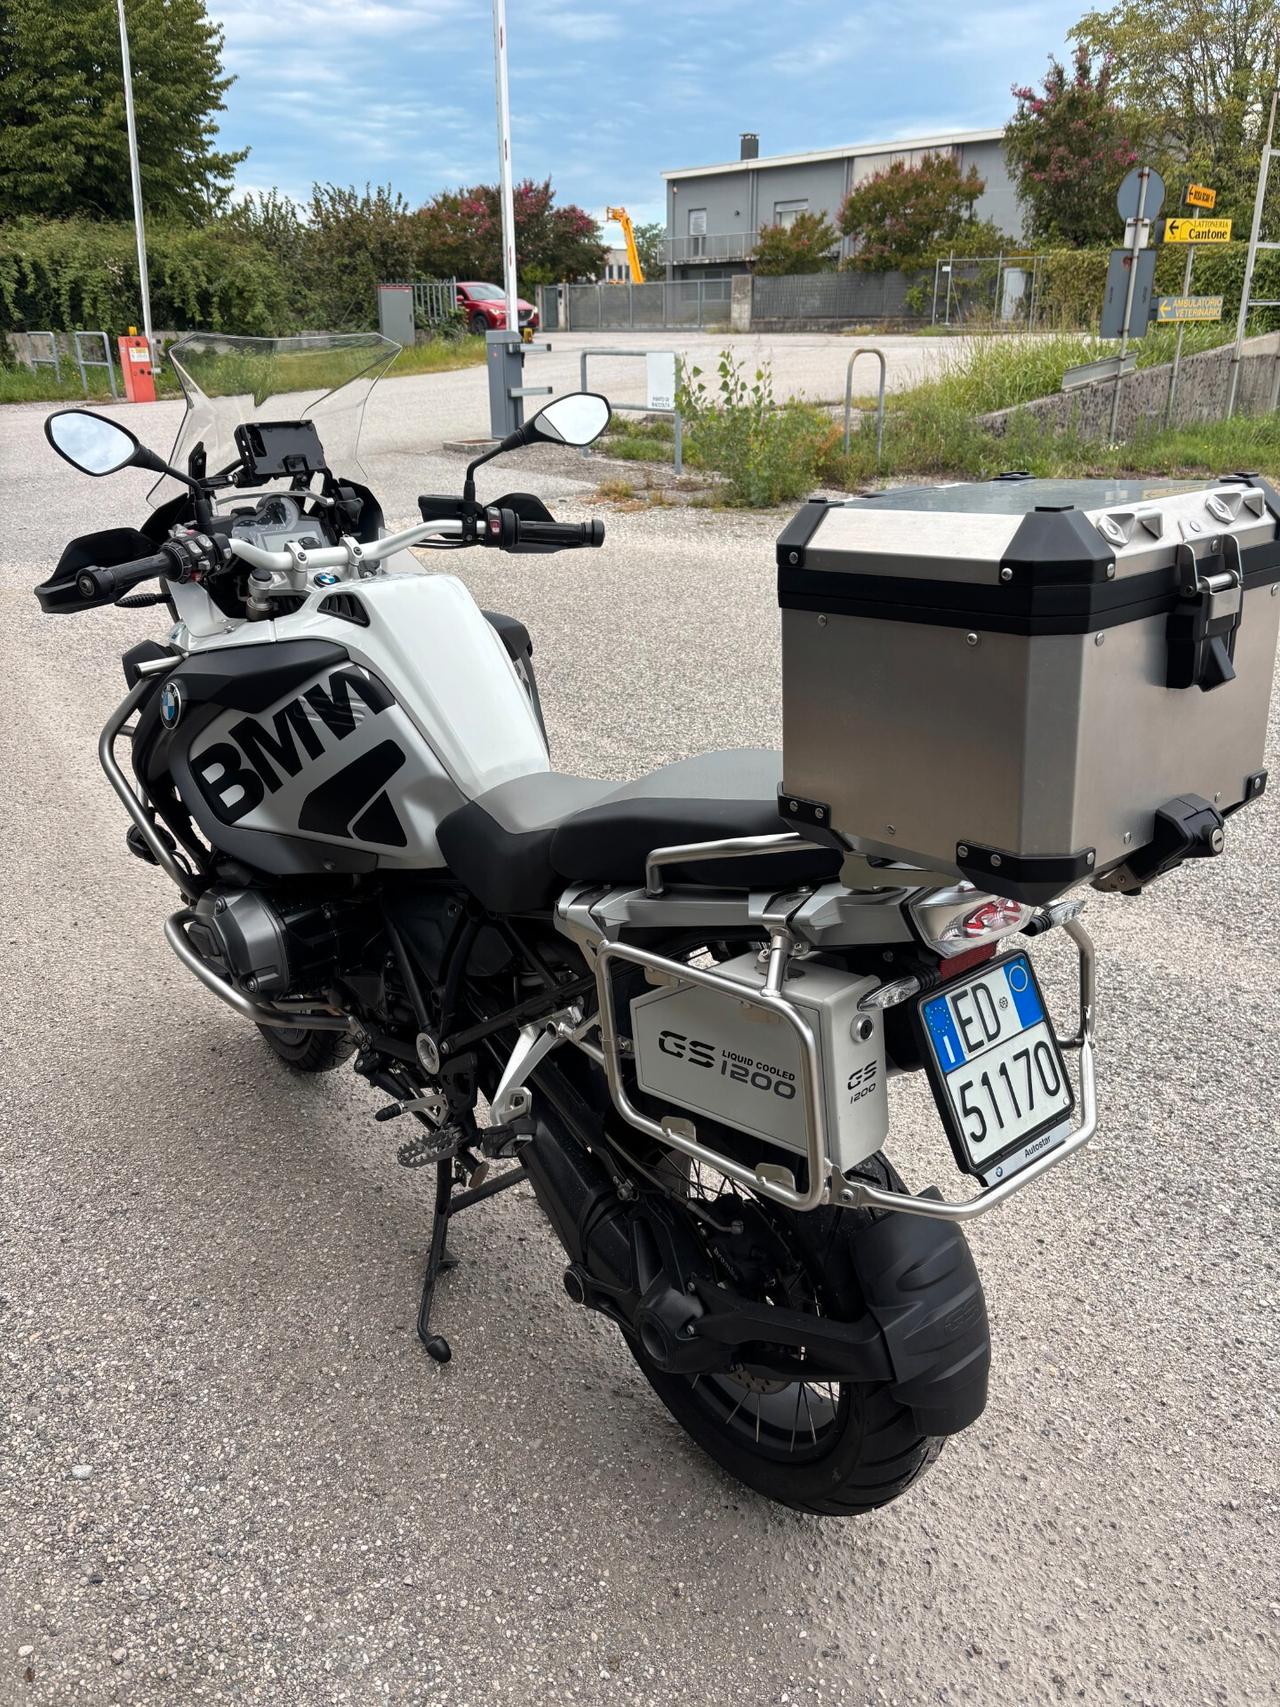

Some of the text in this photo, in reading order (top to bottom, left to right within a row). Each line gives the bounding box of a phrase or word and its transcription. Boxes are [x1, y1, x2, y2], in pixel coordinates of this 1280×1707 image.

[1188, 228, 1228, 240] Cantone
[1193, 220, 1228, 228] LATTONERIA
[1173, 297, 1222, 308] AMBULATORIO
[1175, 308, 1221, 318] VETERINARIO
[190, 664, 397, 827] BMW
[950, 982, 1001, 1054] ED
[658, 1030, 715, 1068] GS
[720, 1060, 796, 1100] 1200
[721, 1049, 796, 1081] LIQUID COOLED
[847, 1060, 877, 1091] GS
[850, 1082, 877, 1104] 1200
[958, 1040, 1061, 1143] 51170
[1023, 1135, 1051, 1159] Autostar
